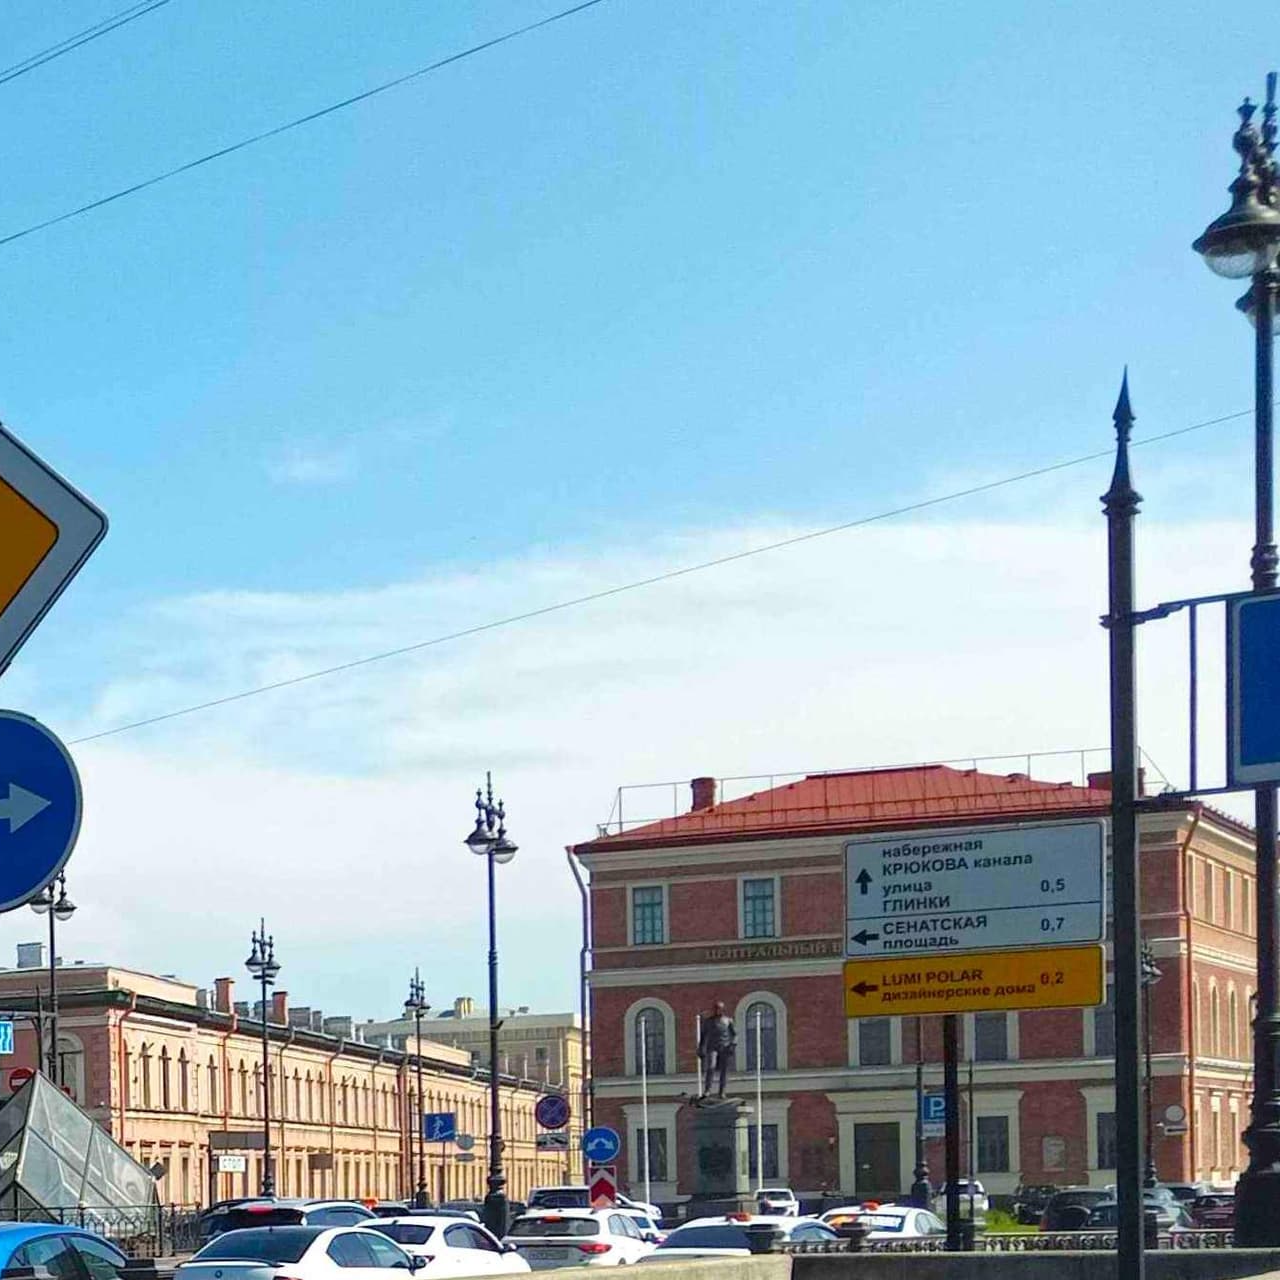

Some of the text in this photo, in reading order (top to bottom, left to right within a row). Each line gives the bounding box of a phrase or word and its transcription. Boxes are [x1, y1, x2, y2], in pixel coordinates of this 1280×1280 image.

[882, 837, 983, 859] набережная
[882, 853, 1033, 877] КРЮКОВА канала
[882, 878, 1065, 898] улица 0,5
[883, 896, 951, 914] ГЛИНКИ
[883, 915, 1065, 936] СЕНАТСКАЯ 0,7
[882, 935, 959, 951] площадь
[882, 968, 1065, 988] LUMI POLAR 0,2
[881, 982, 1036, 1003] дизайнерские дома
